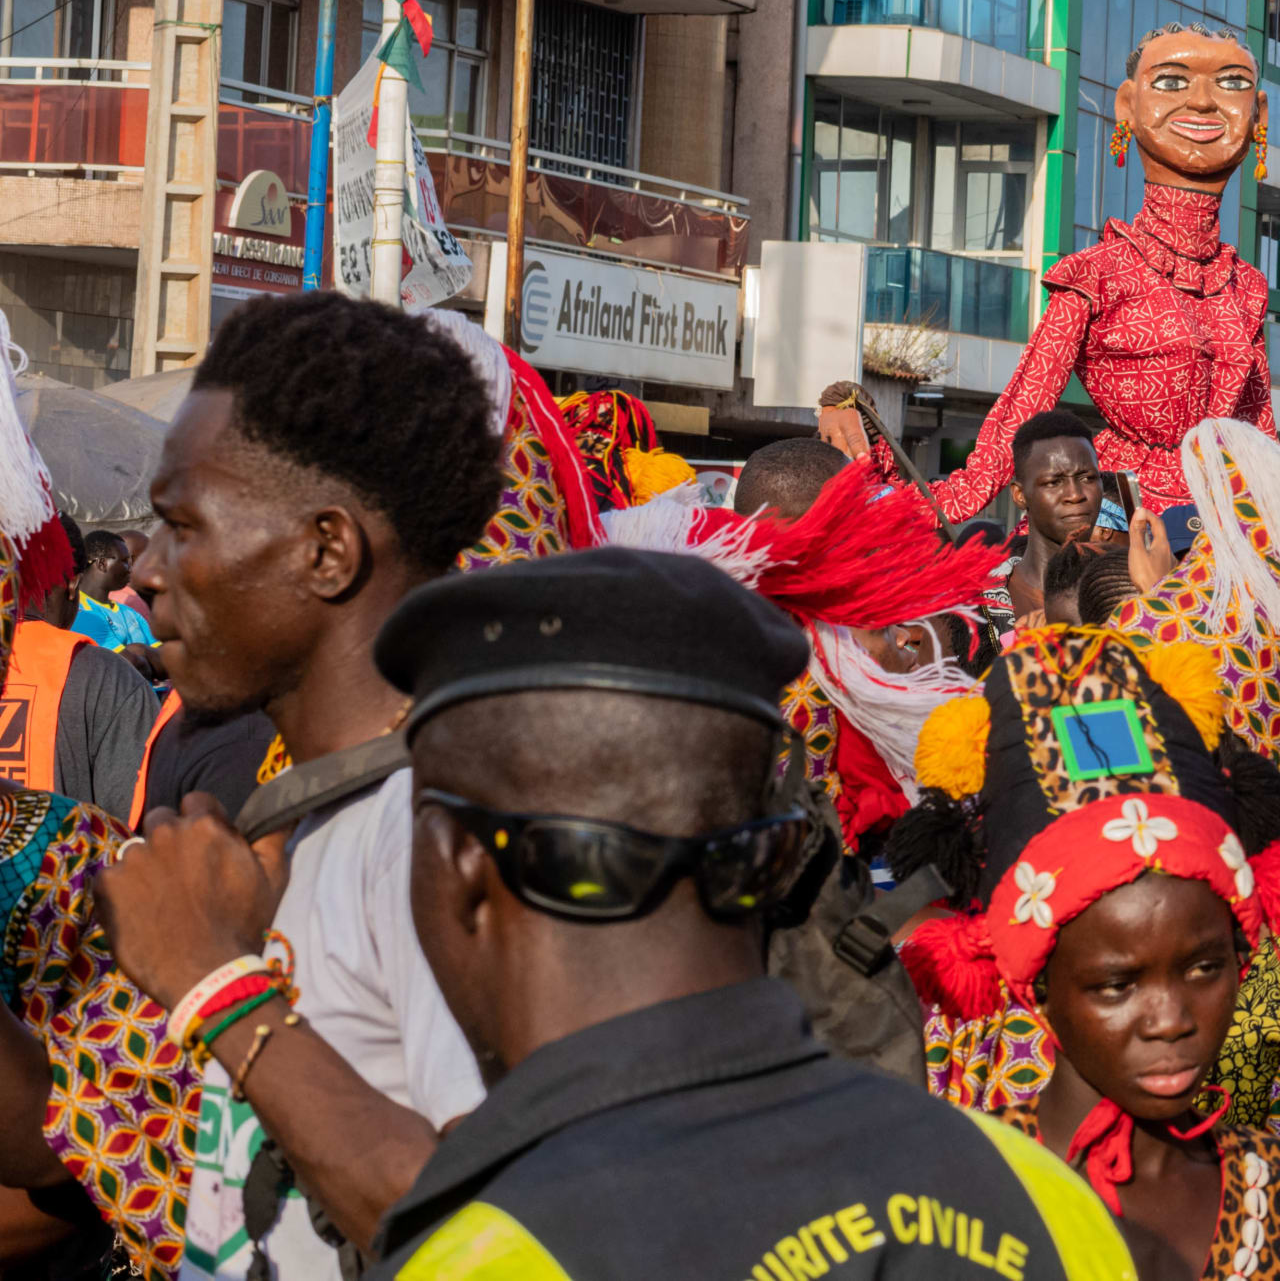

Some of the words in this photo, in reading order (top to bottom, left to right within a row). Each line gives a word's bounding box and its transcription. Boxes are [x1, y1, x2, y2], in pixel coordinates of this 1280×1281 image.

[556, 279, 637, 343] Afriland
[638, 293, 678, 350] First
[681, 301, 728, 357] Bank
[887, 1193, 1030, 1281] CIVILE
